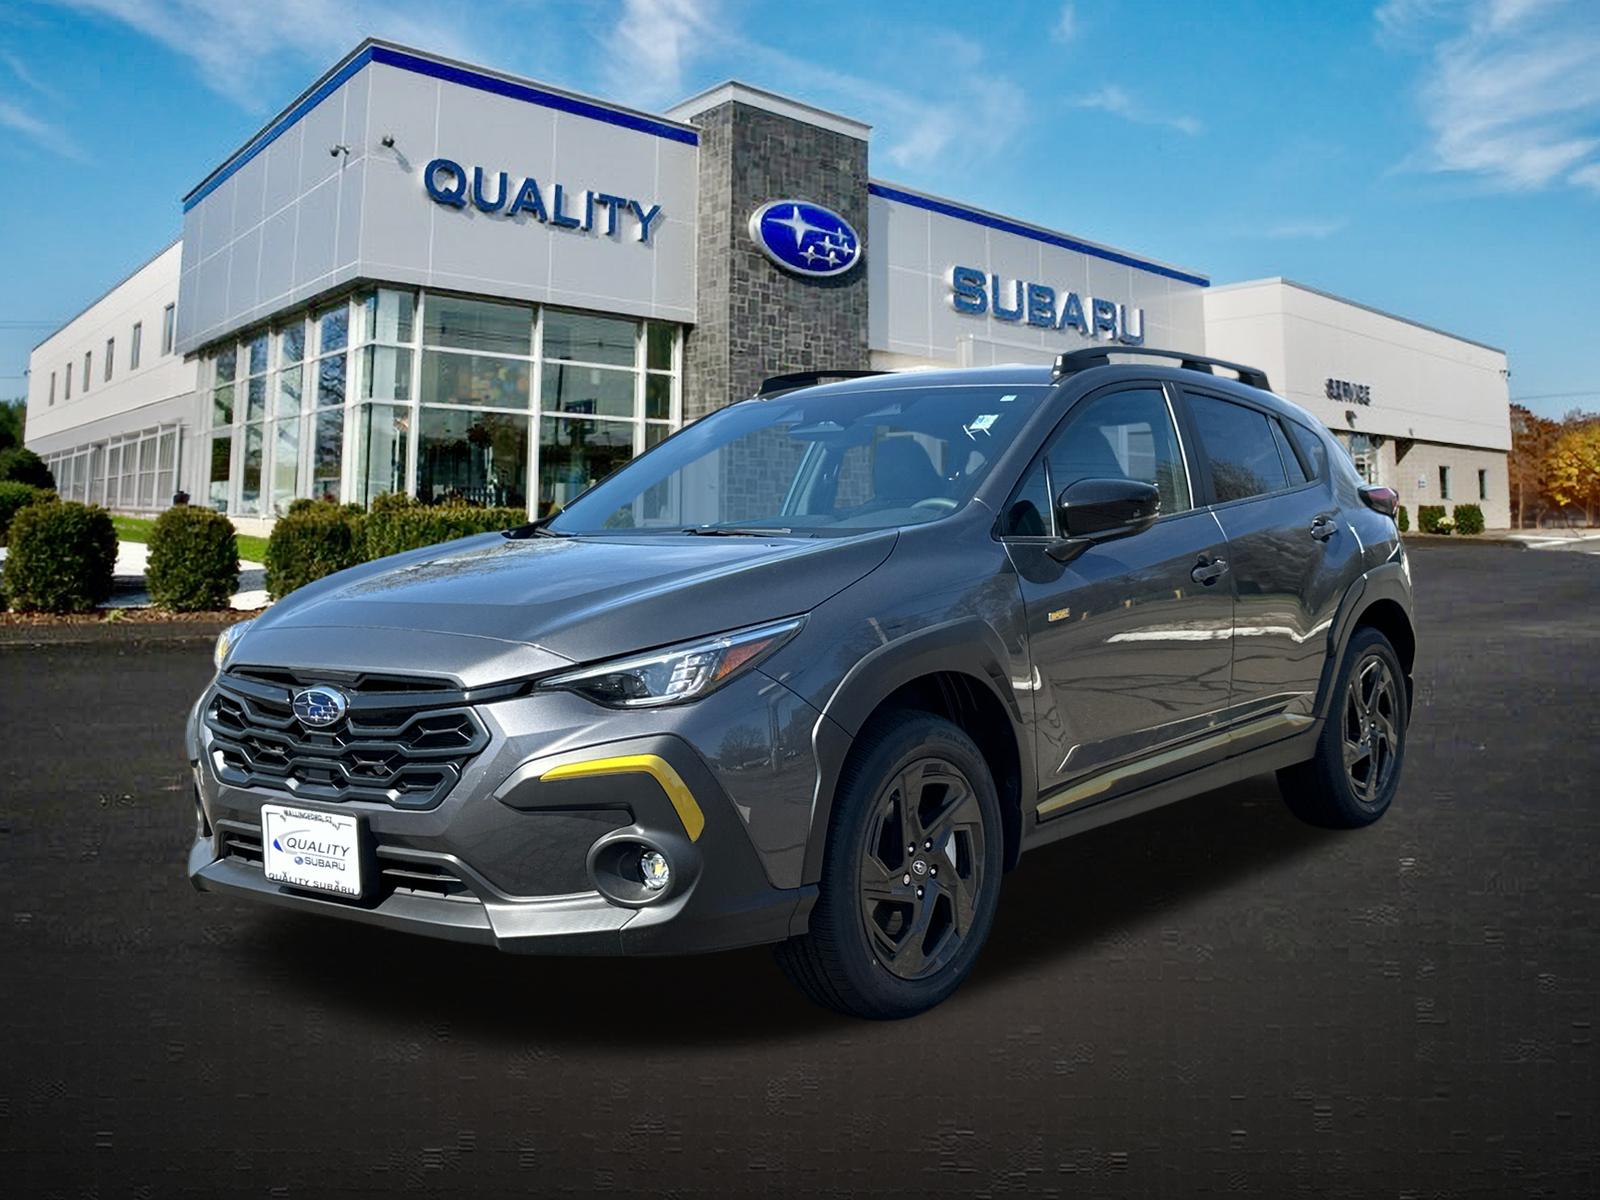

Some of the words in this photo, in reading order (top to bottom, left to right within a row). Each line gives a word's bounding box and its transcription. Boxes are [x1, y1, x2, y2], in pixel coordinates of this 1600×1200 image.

[422, 158, 662, 243] QUALITY
[949, 265, 1145, 346] SUBARU
[286, 837, 350, 857] QUALITY
[304, 856, 345, 871] SUBARU
[268, 872, 310, 886] QUALITY
[313, 880, 355, 895] SUBARU
